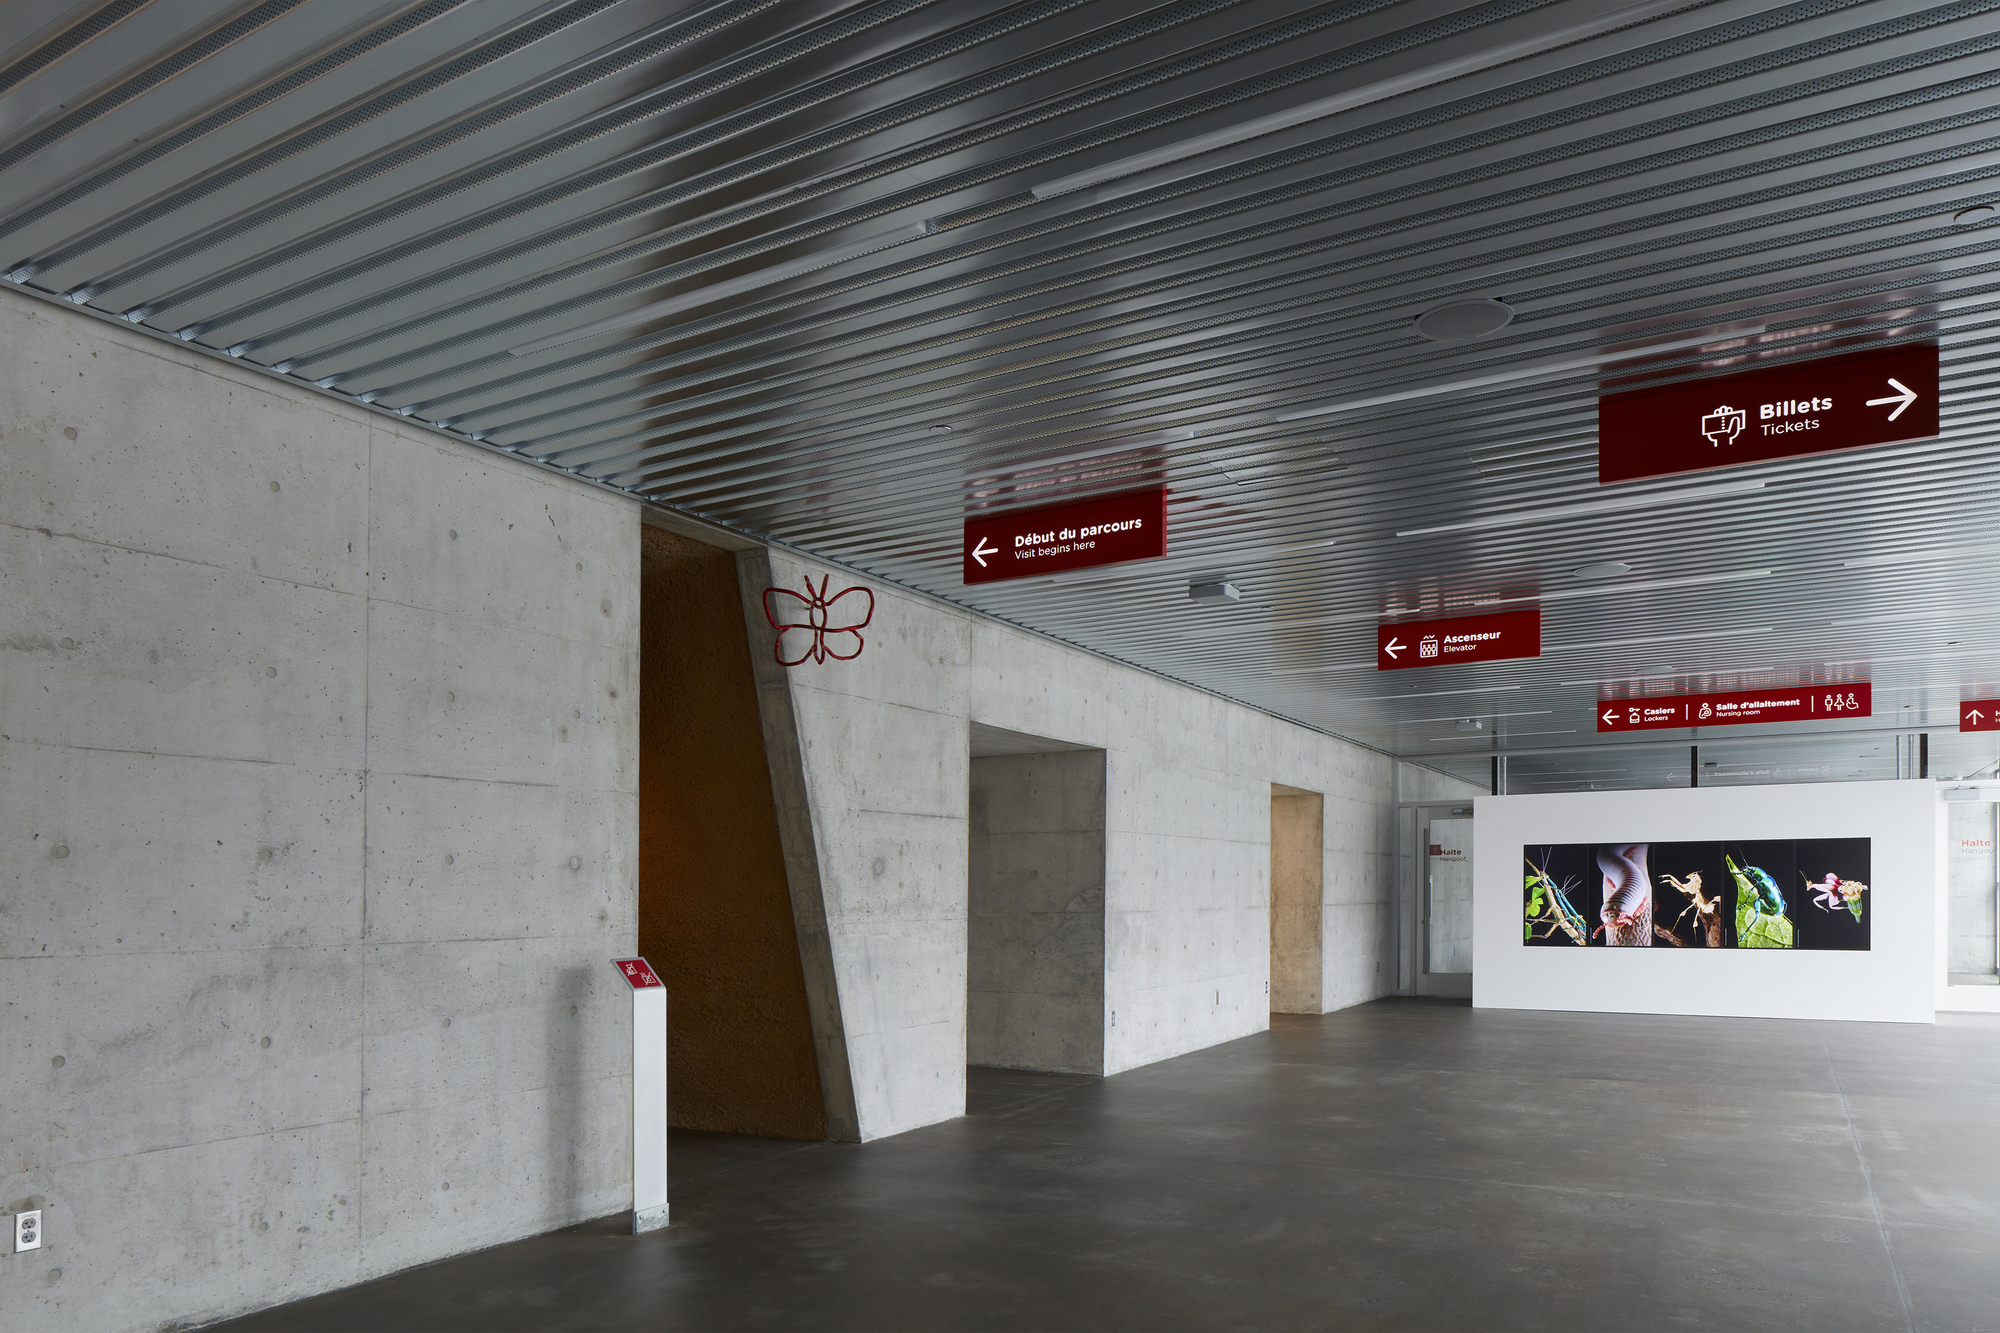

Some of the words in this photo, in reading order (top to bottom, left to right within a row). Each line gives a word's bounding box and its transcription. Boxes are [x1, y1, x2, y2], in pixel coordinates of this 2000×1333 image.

[1760, 397, 1833, 419] Billets
[1760, 419, 1820, 436] Tickets
[1015, 531, 1055, 547] Début
[1059, 528, 1076, 540] du
[1080, 518, 1142, 539] parcours
[1015, 549, 1036, 559] Visit
[1038, 545, 1071, 557] begins
[1073, 541, 1096, 551] here
[1443, 631, 1501, 644] Ascenseur
[1443, 644, 1477, 653] Elevator
[1716, 703, 1738, 711] Salle
[1740, 699, 1800, 709] d'allaitement
[1961, 839, 1991, 847] Halte
